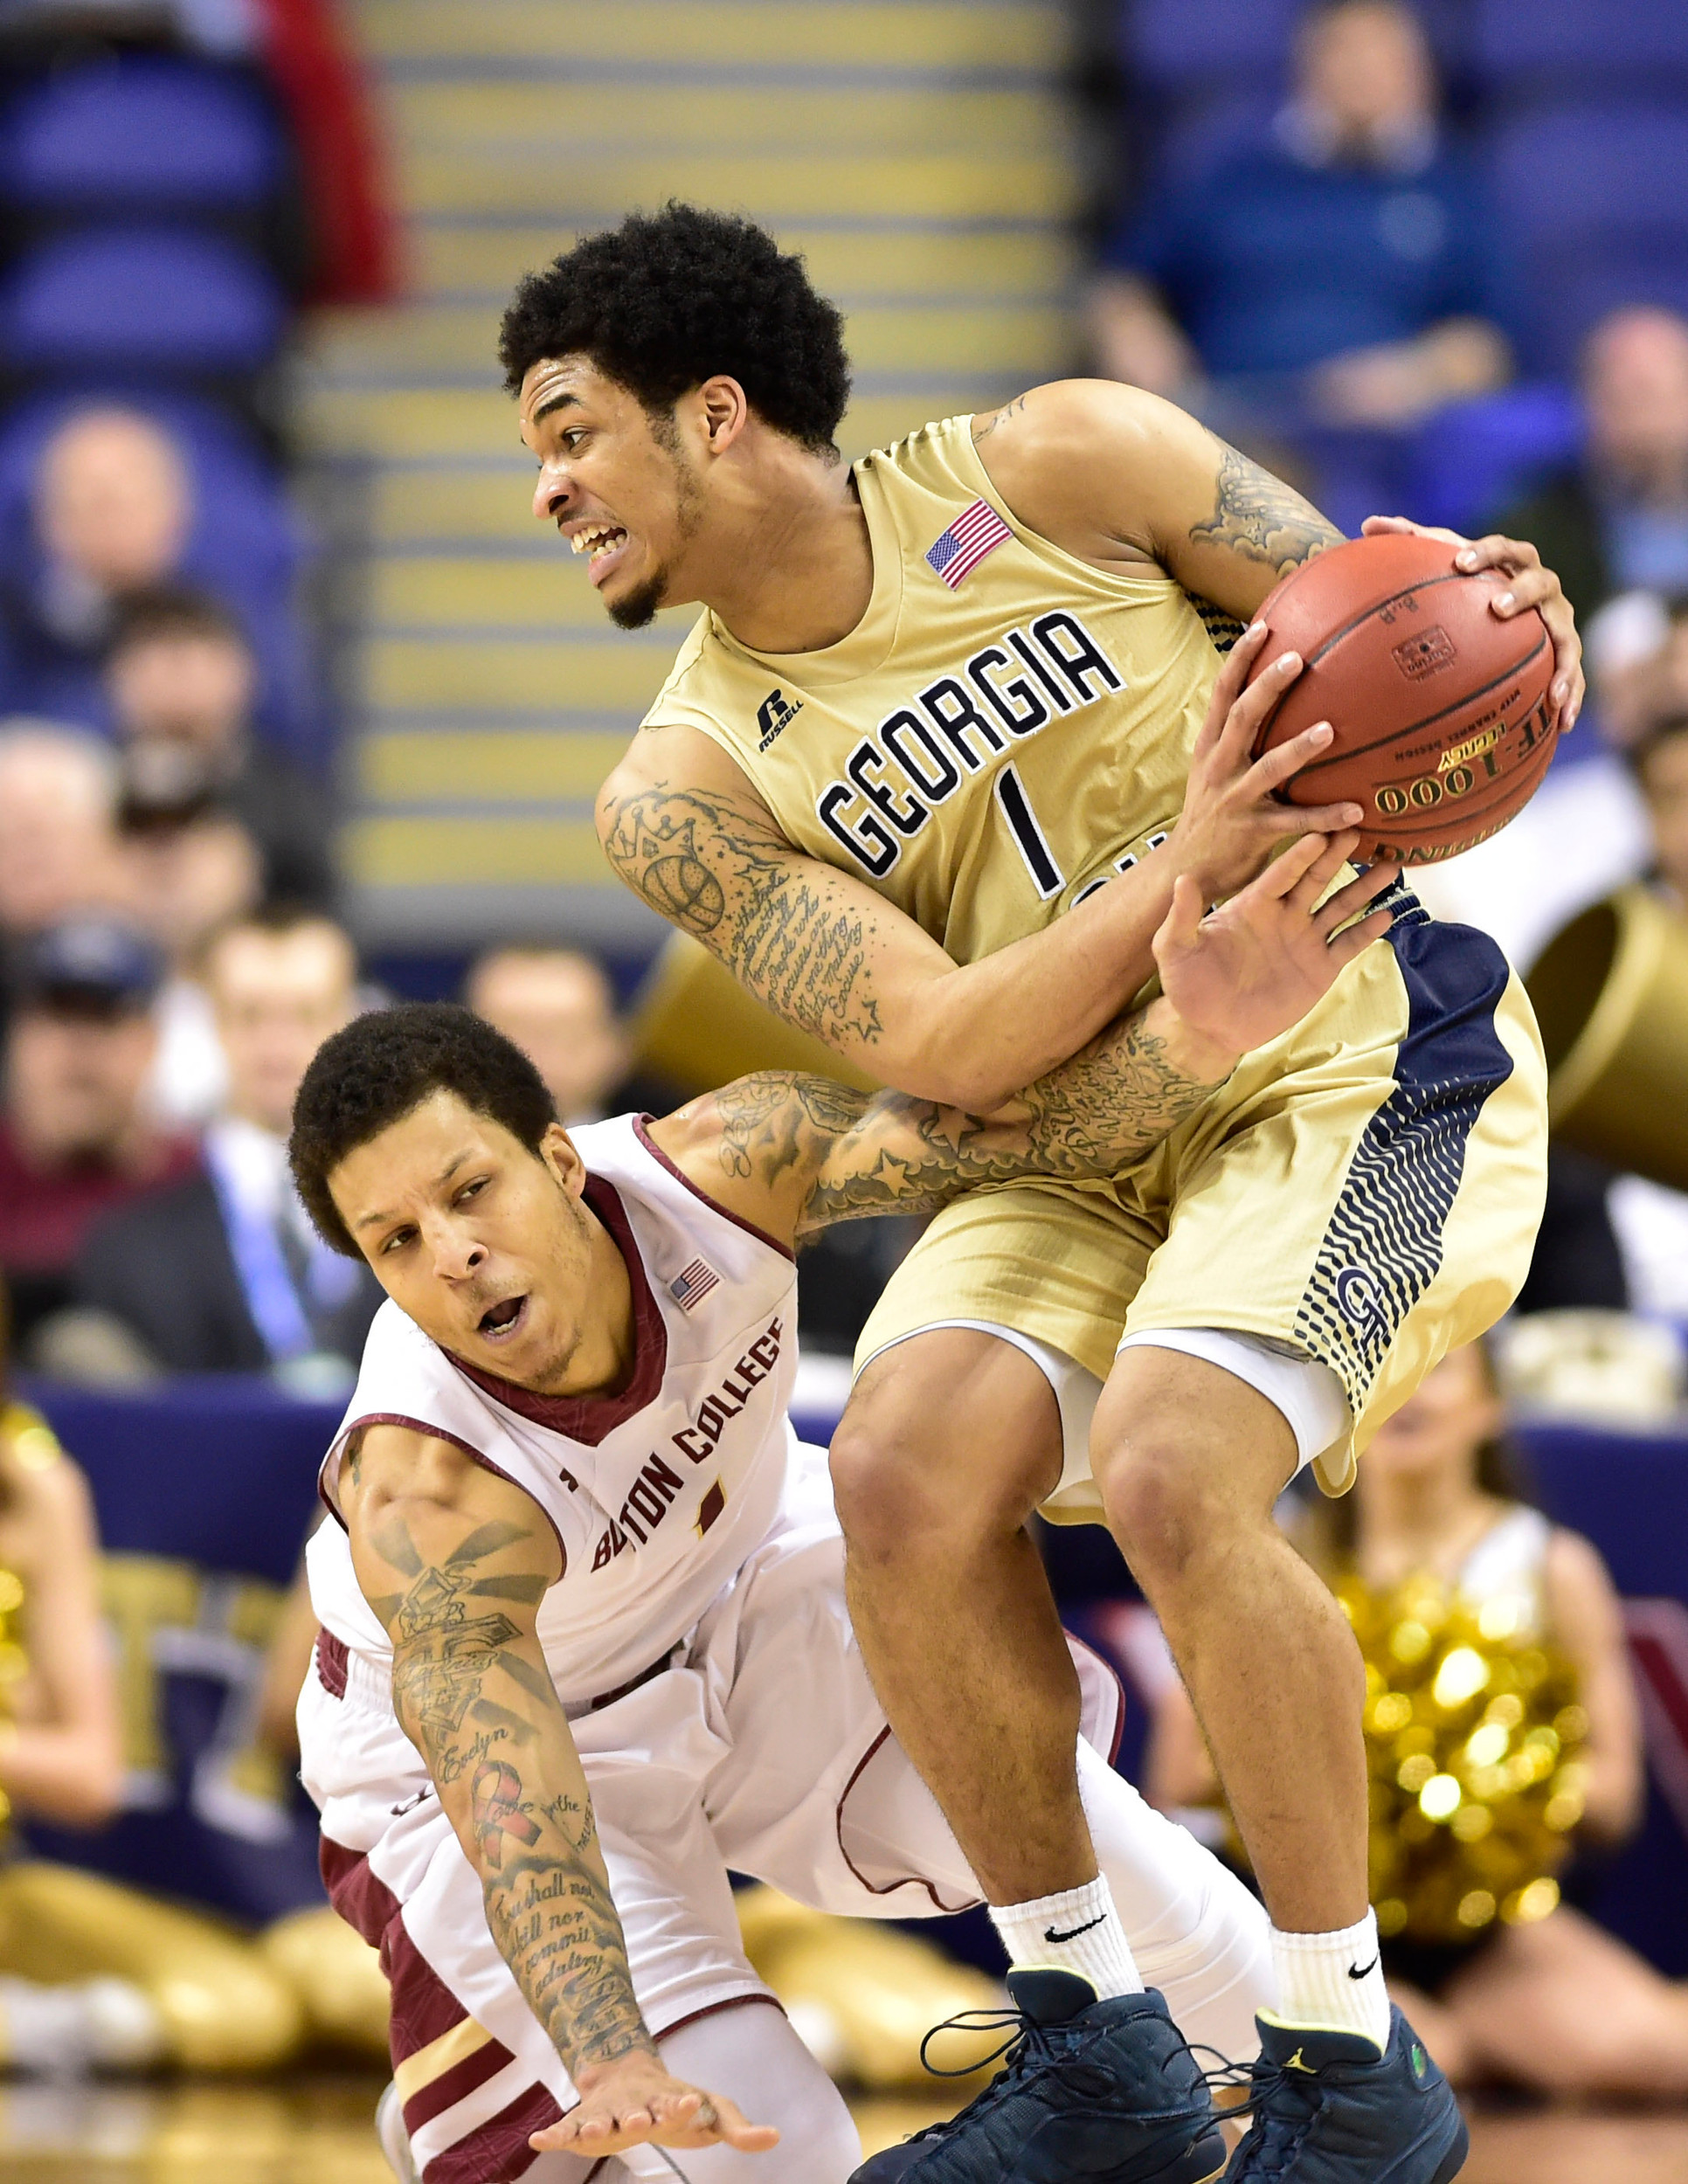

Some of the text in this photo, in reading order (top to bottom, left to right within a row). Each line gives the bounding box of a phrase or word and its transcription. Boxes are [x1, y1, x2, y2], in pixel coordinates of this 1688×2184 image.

[758, 699, 805, 753] RUSSELL
[814, 608, 1128, 880] GEORGIA
[1437, 721, 1507, 774] LEGACY
[993, 758, 1067, 901] 1
[591, 1317, 783, 1573] BOTON COLLEGE
[556, 1794, 580, 1813] the
[549, 1911, 585, 1932] nor
[525, 1926, 590, 1975] commit
